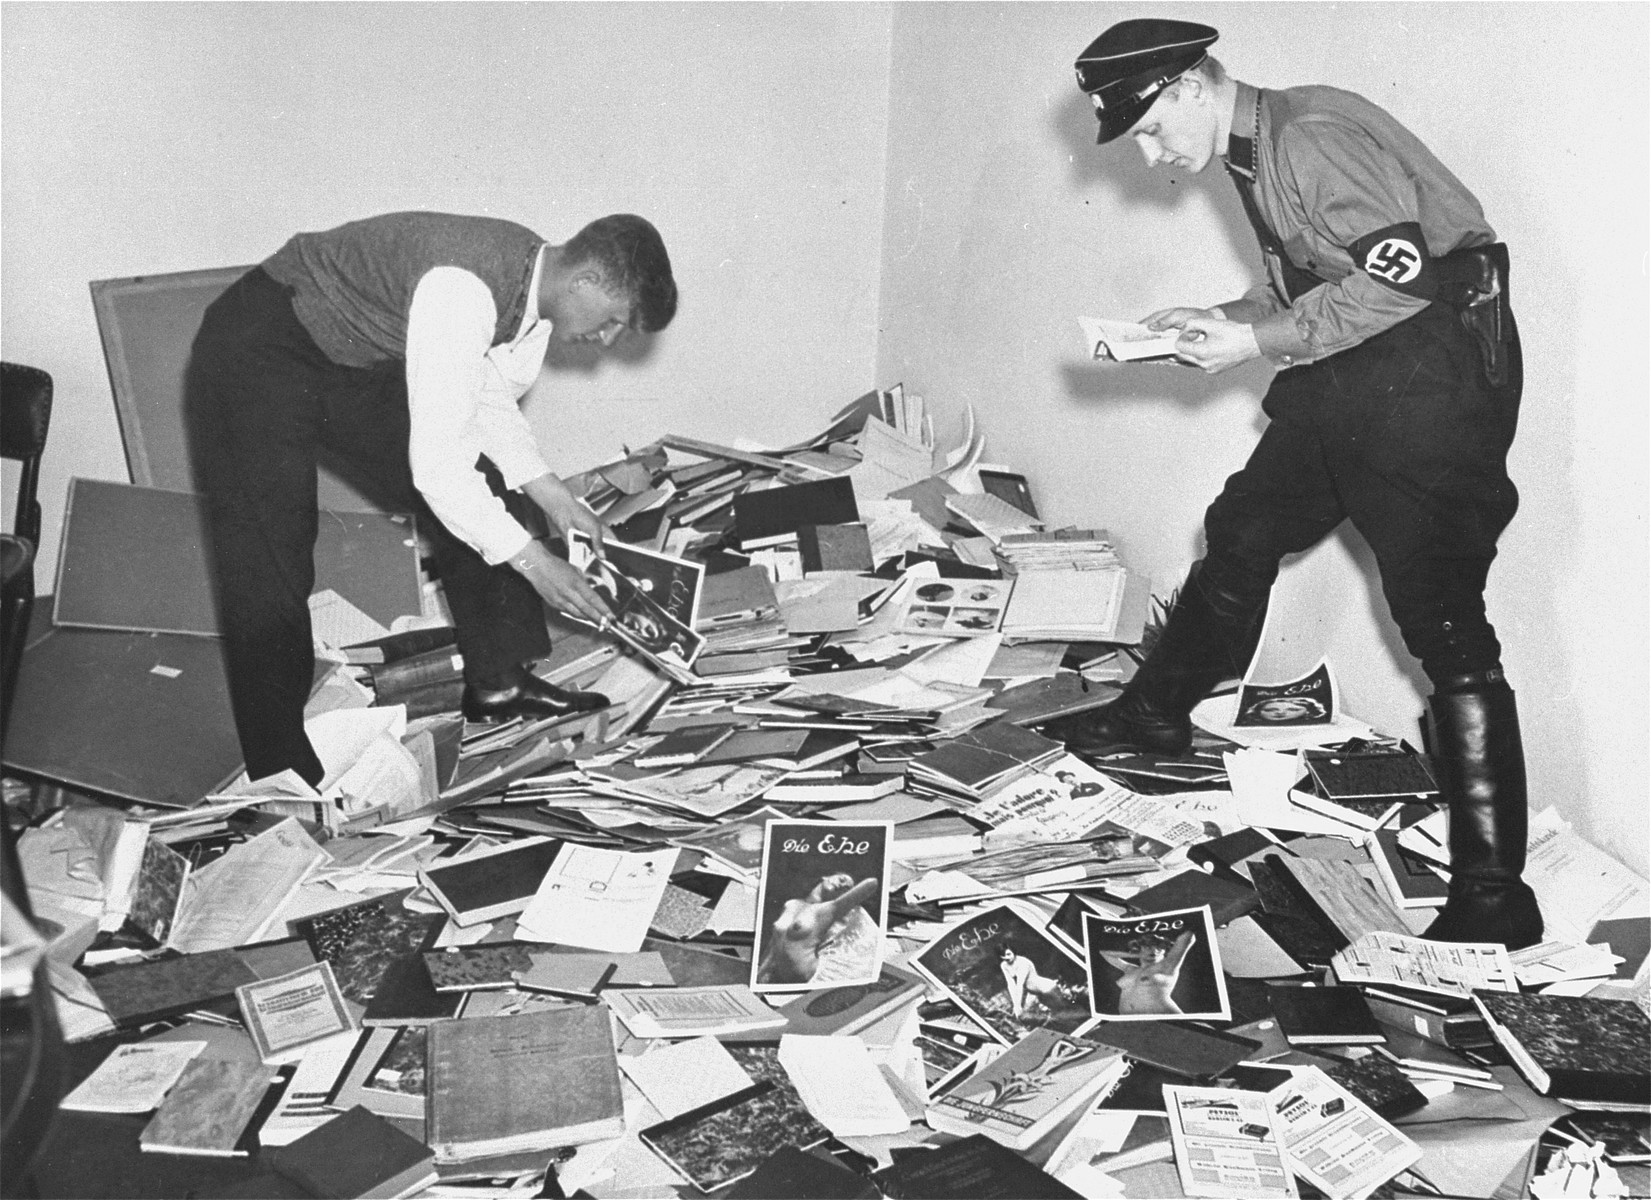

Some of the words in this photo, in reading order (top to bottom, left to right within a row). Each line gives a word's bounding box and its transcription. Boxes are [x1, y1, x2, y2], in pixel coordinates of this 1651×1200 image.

[782, 838, 810, 853] Die
[817, 833, 870, 855] Ehe
[958, 923, 1000, 950] Ehe
[1104, 925, 1131, 934] Die
[1134, 919, 1184, 934] Ehe
